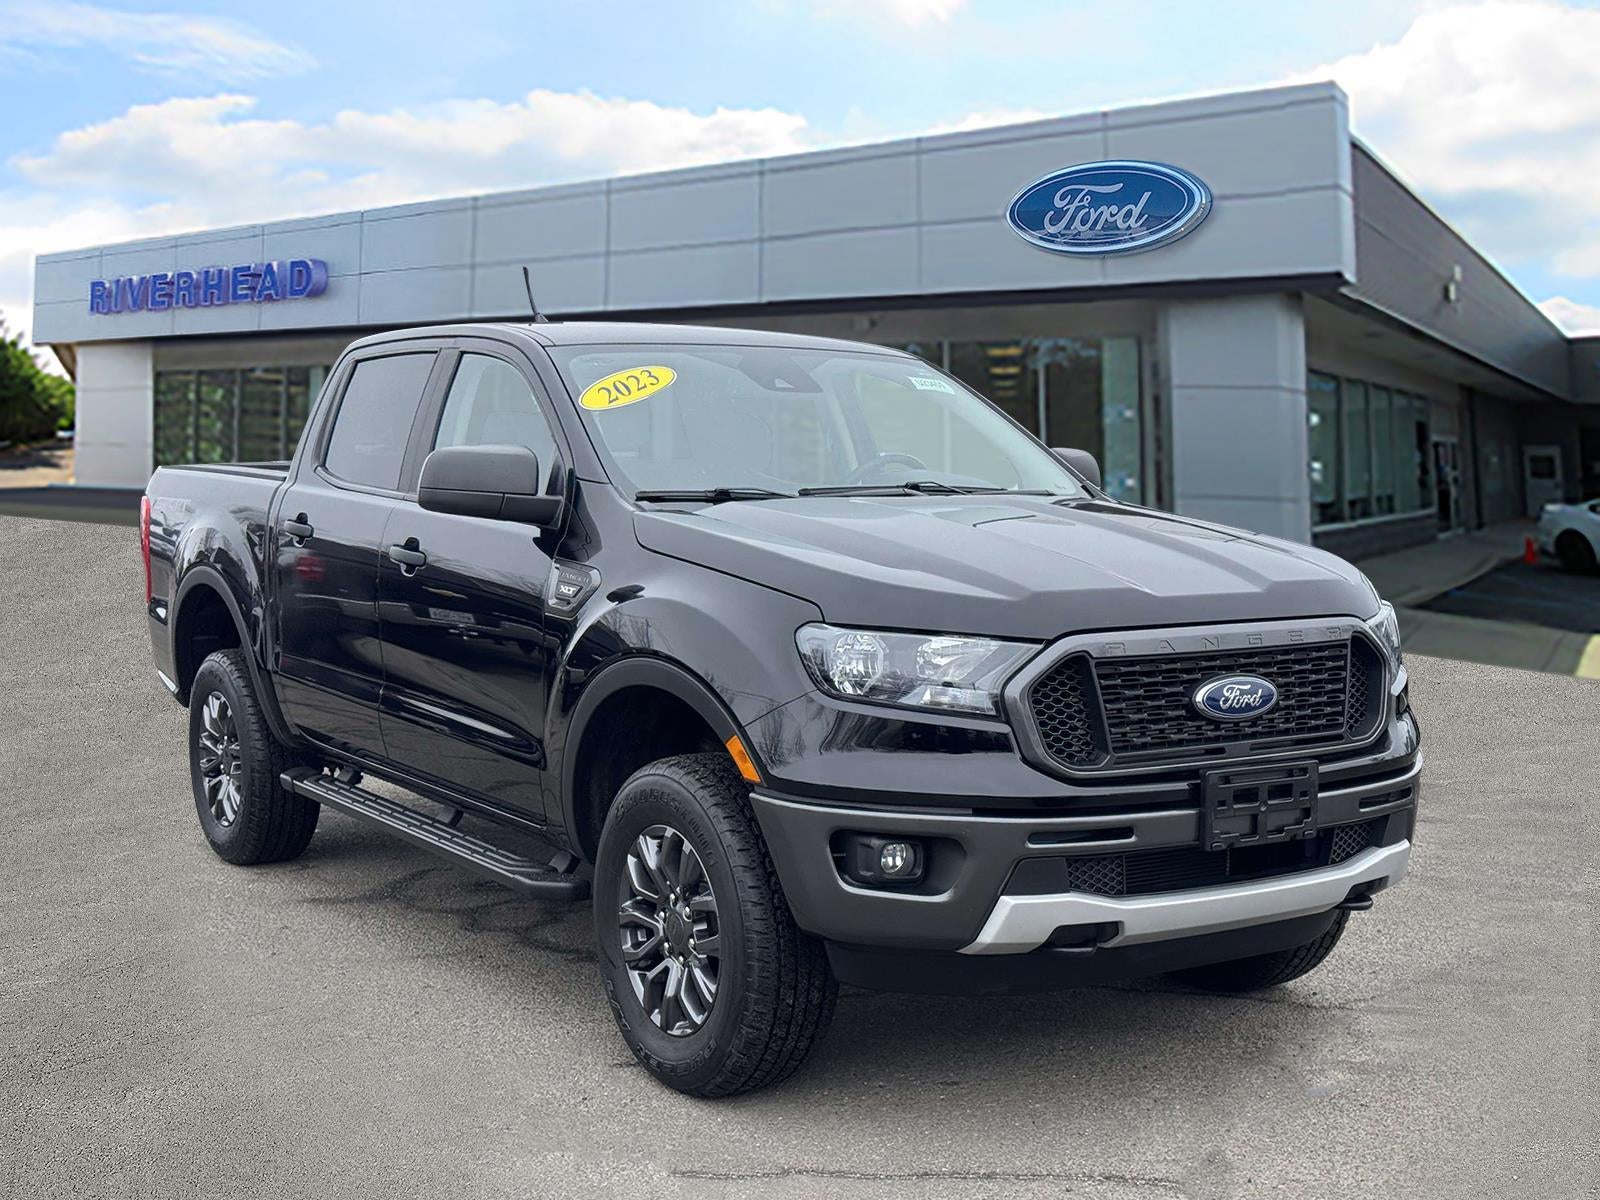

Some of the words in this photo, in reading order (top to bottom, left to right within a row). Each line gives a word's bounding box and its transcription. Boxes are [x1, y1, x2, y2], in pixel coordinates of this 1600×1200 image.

[1043, 182, 1152, 234] Ford
[89, 258, 324, 314] RIVERHEAD
[597, 369, 660, 404] 2023
[559, 584, 577, 595] XLT
[1105, 627, 1342, 655] RANGER
[1219, 684, 1263, 709] Ford
